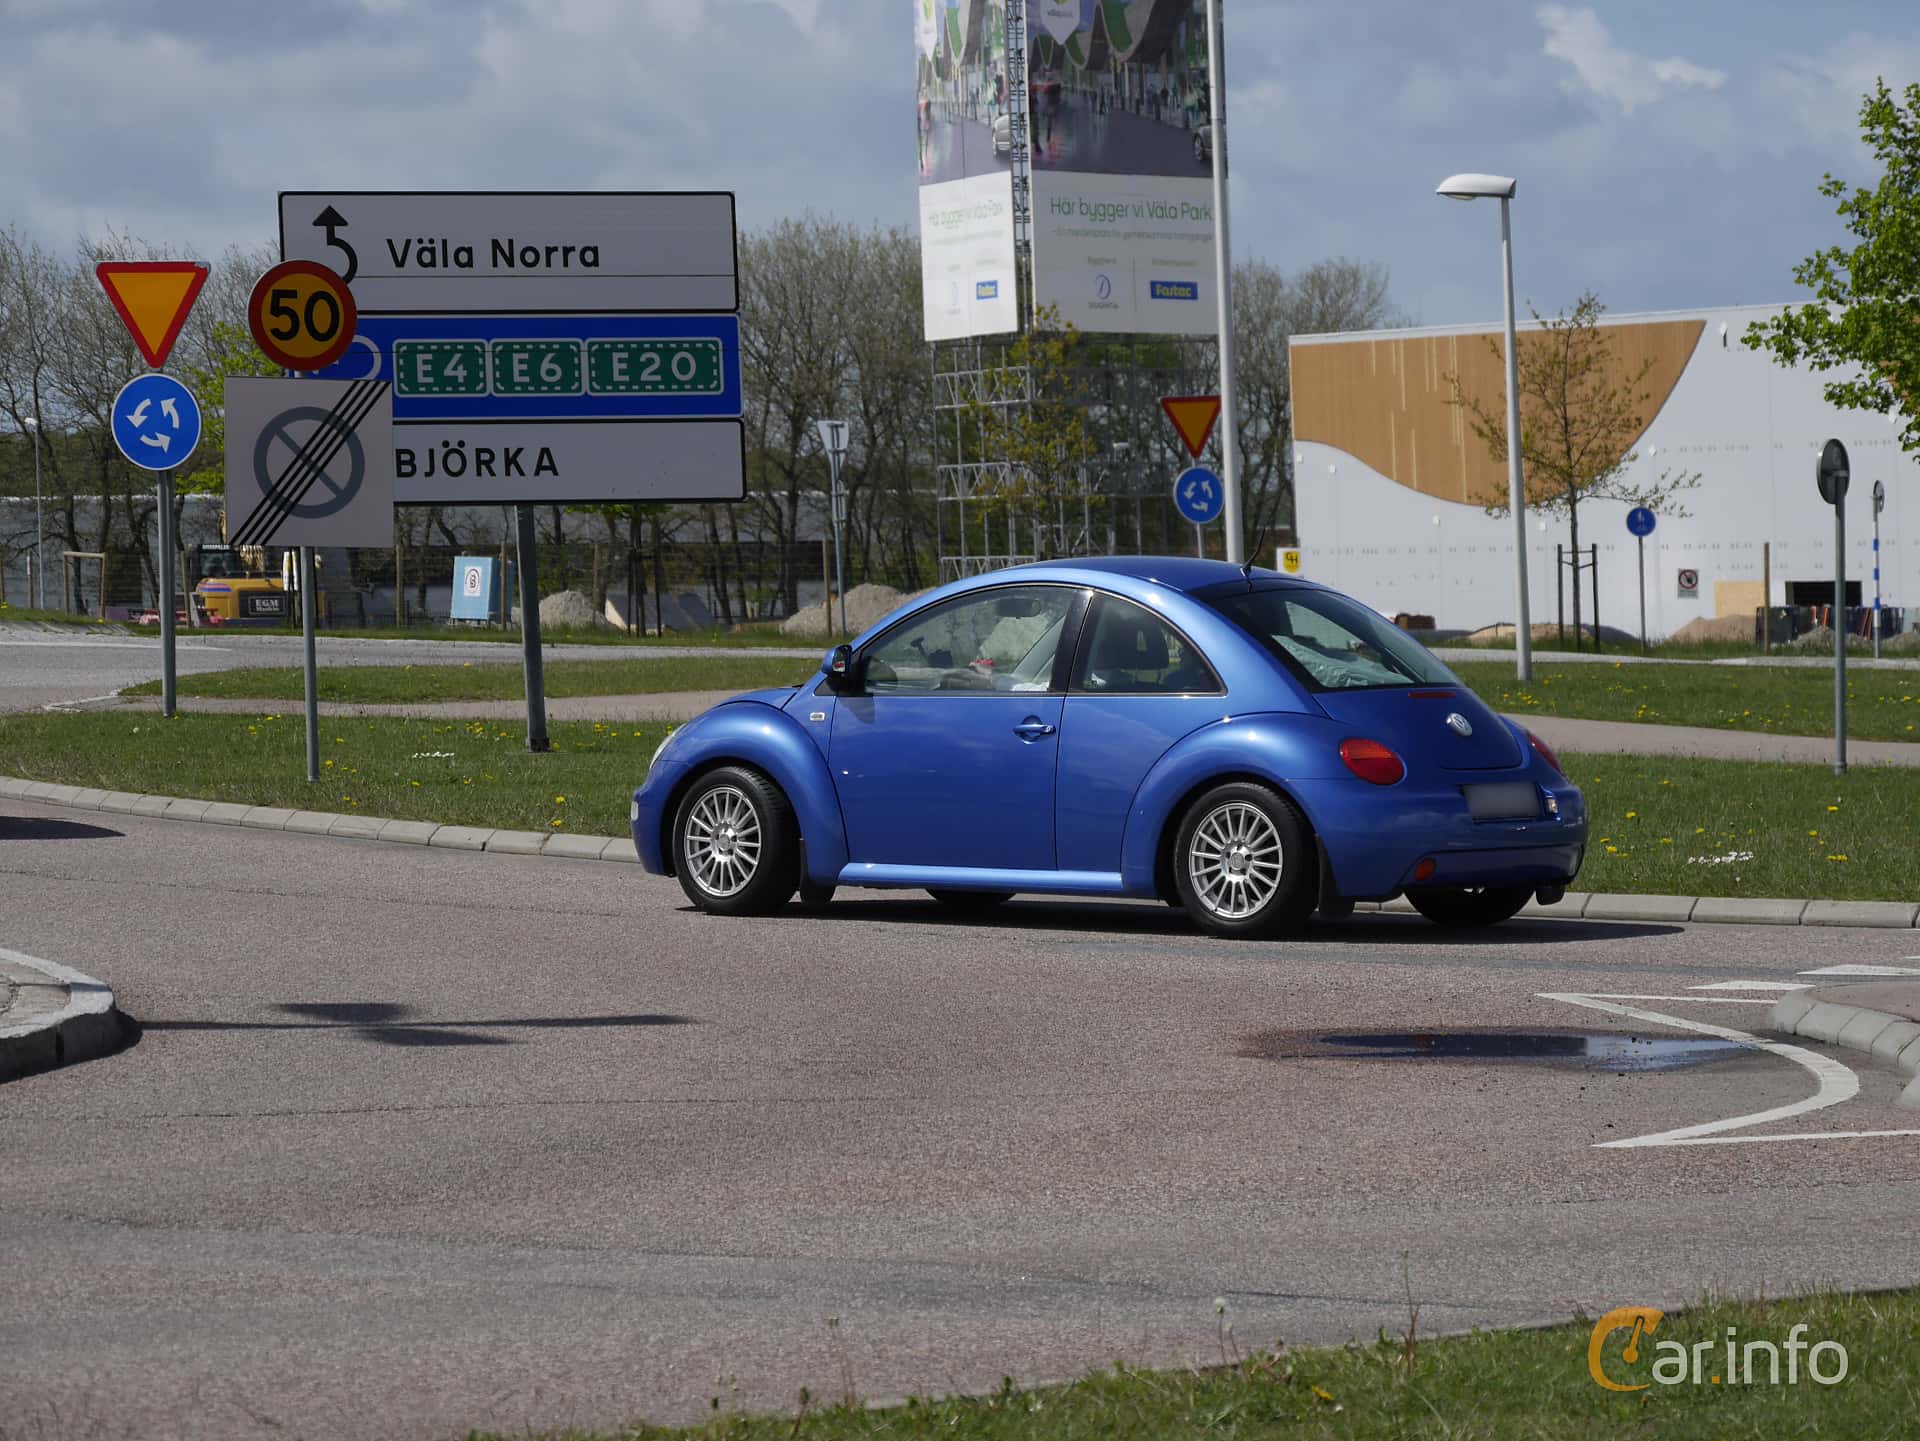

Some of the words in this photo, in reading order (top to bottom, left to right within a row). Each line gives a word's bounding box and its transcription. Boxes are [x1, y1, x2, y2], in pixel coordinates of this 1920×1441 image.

[1080, 197, 1128, 222] bygger
[1134, 201, 1144, 218] vi
[1181, 202, 1213, 221] Park
[386, 238, 474, 269] Väla
[491, 238, 600, 269] Norra
[269, 288, 341, 342] 50
[612, 350, 698, 383] E20
[395, 440, 559, 478] BJÖRKA
